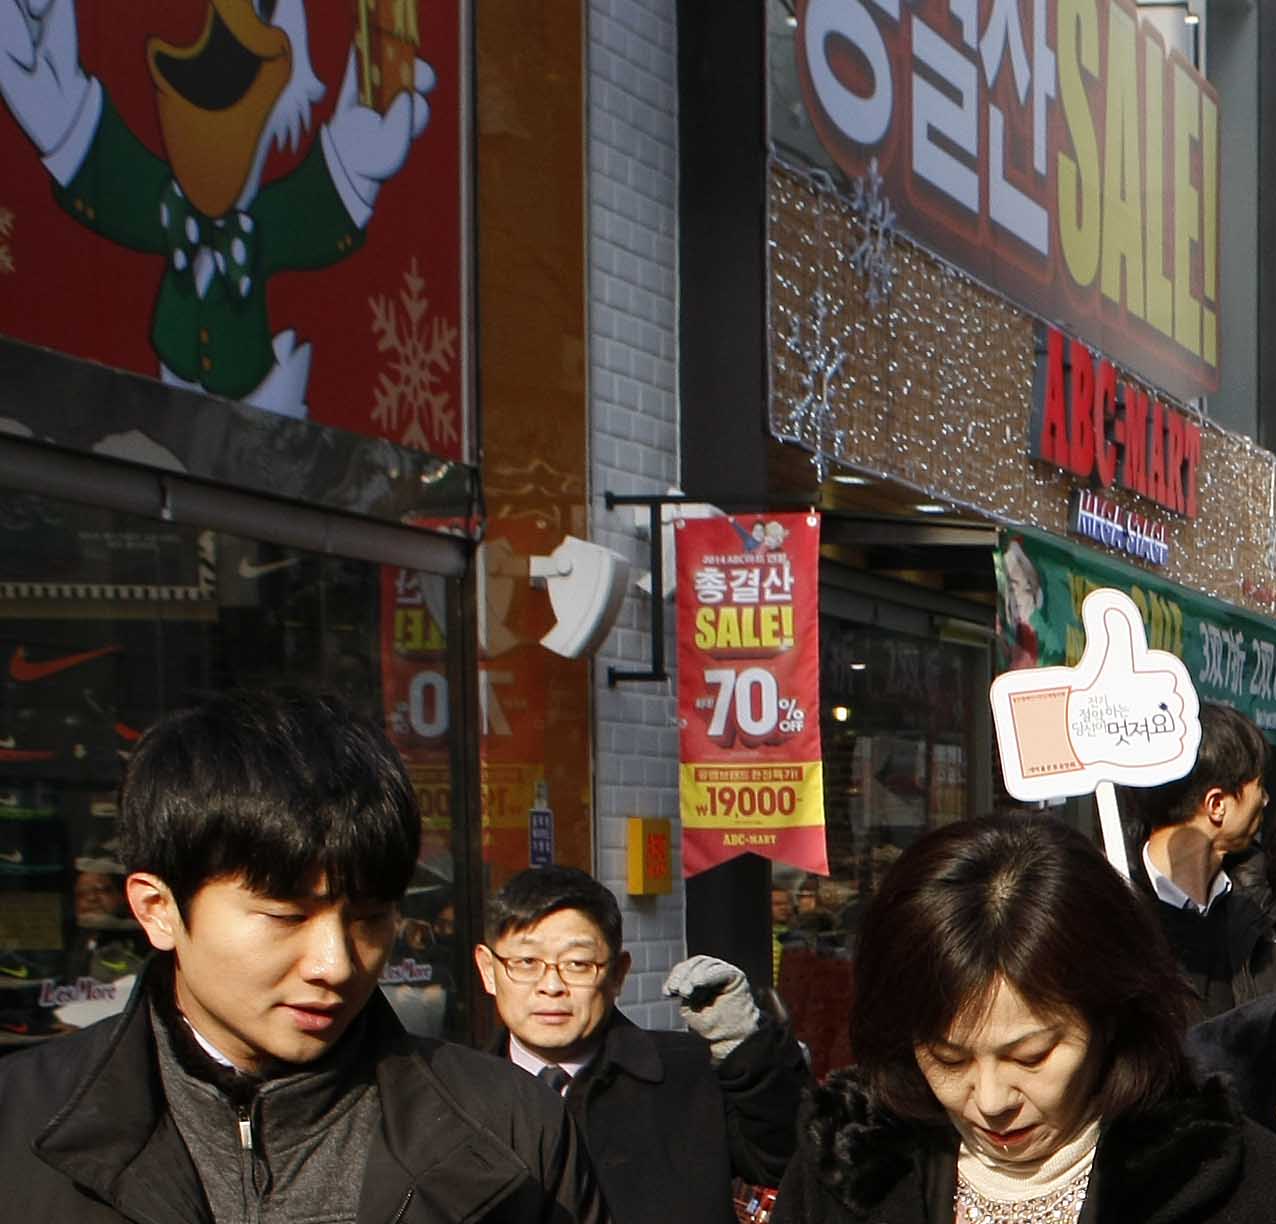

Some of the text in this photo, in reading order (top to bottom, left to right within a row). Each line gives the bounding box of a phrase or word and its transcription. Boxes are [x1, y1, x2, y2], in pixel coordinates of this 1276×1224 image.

[1058, 0, 1217, 367] SALE!
[1040, 326, 1202, 520] ABC-MART
[694, 566, 795, 604] 총결산
[695, 606, 795, 650] SALE!
[1108, 713, 1175, 747] 멋져요
